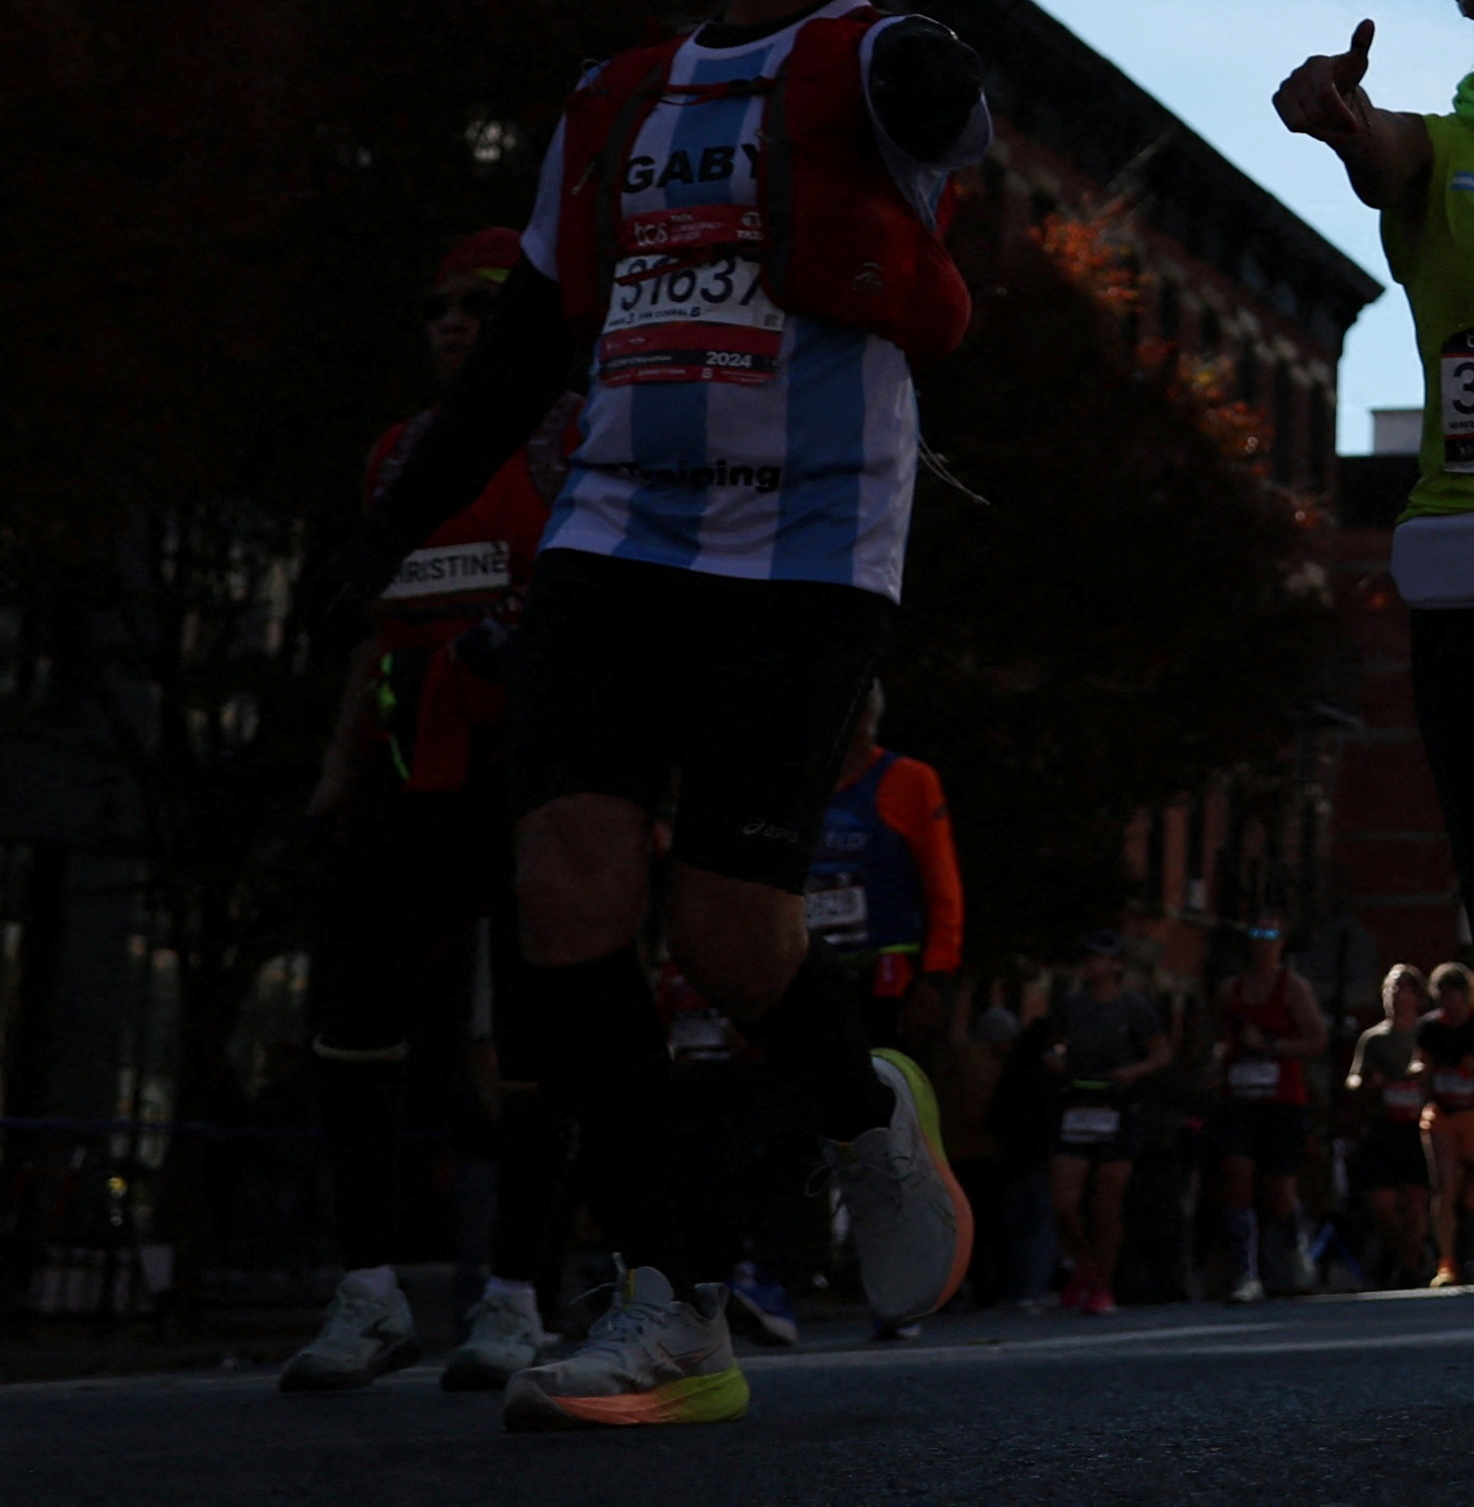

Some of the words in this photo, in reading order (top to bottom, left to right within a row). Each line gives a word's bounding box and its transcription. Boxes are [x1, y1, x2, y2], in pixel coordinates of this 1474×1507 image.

[623, 144, 757, 193] GABY
[620, 254, 763, 311] 31637
[705, 350, 753, 369] 2024
